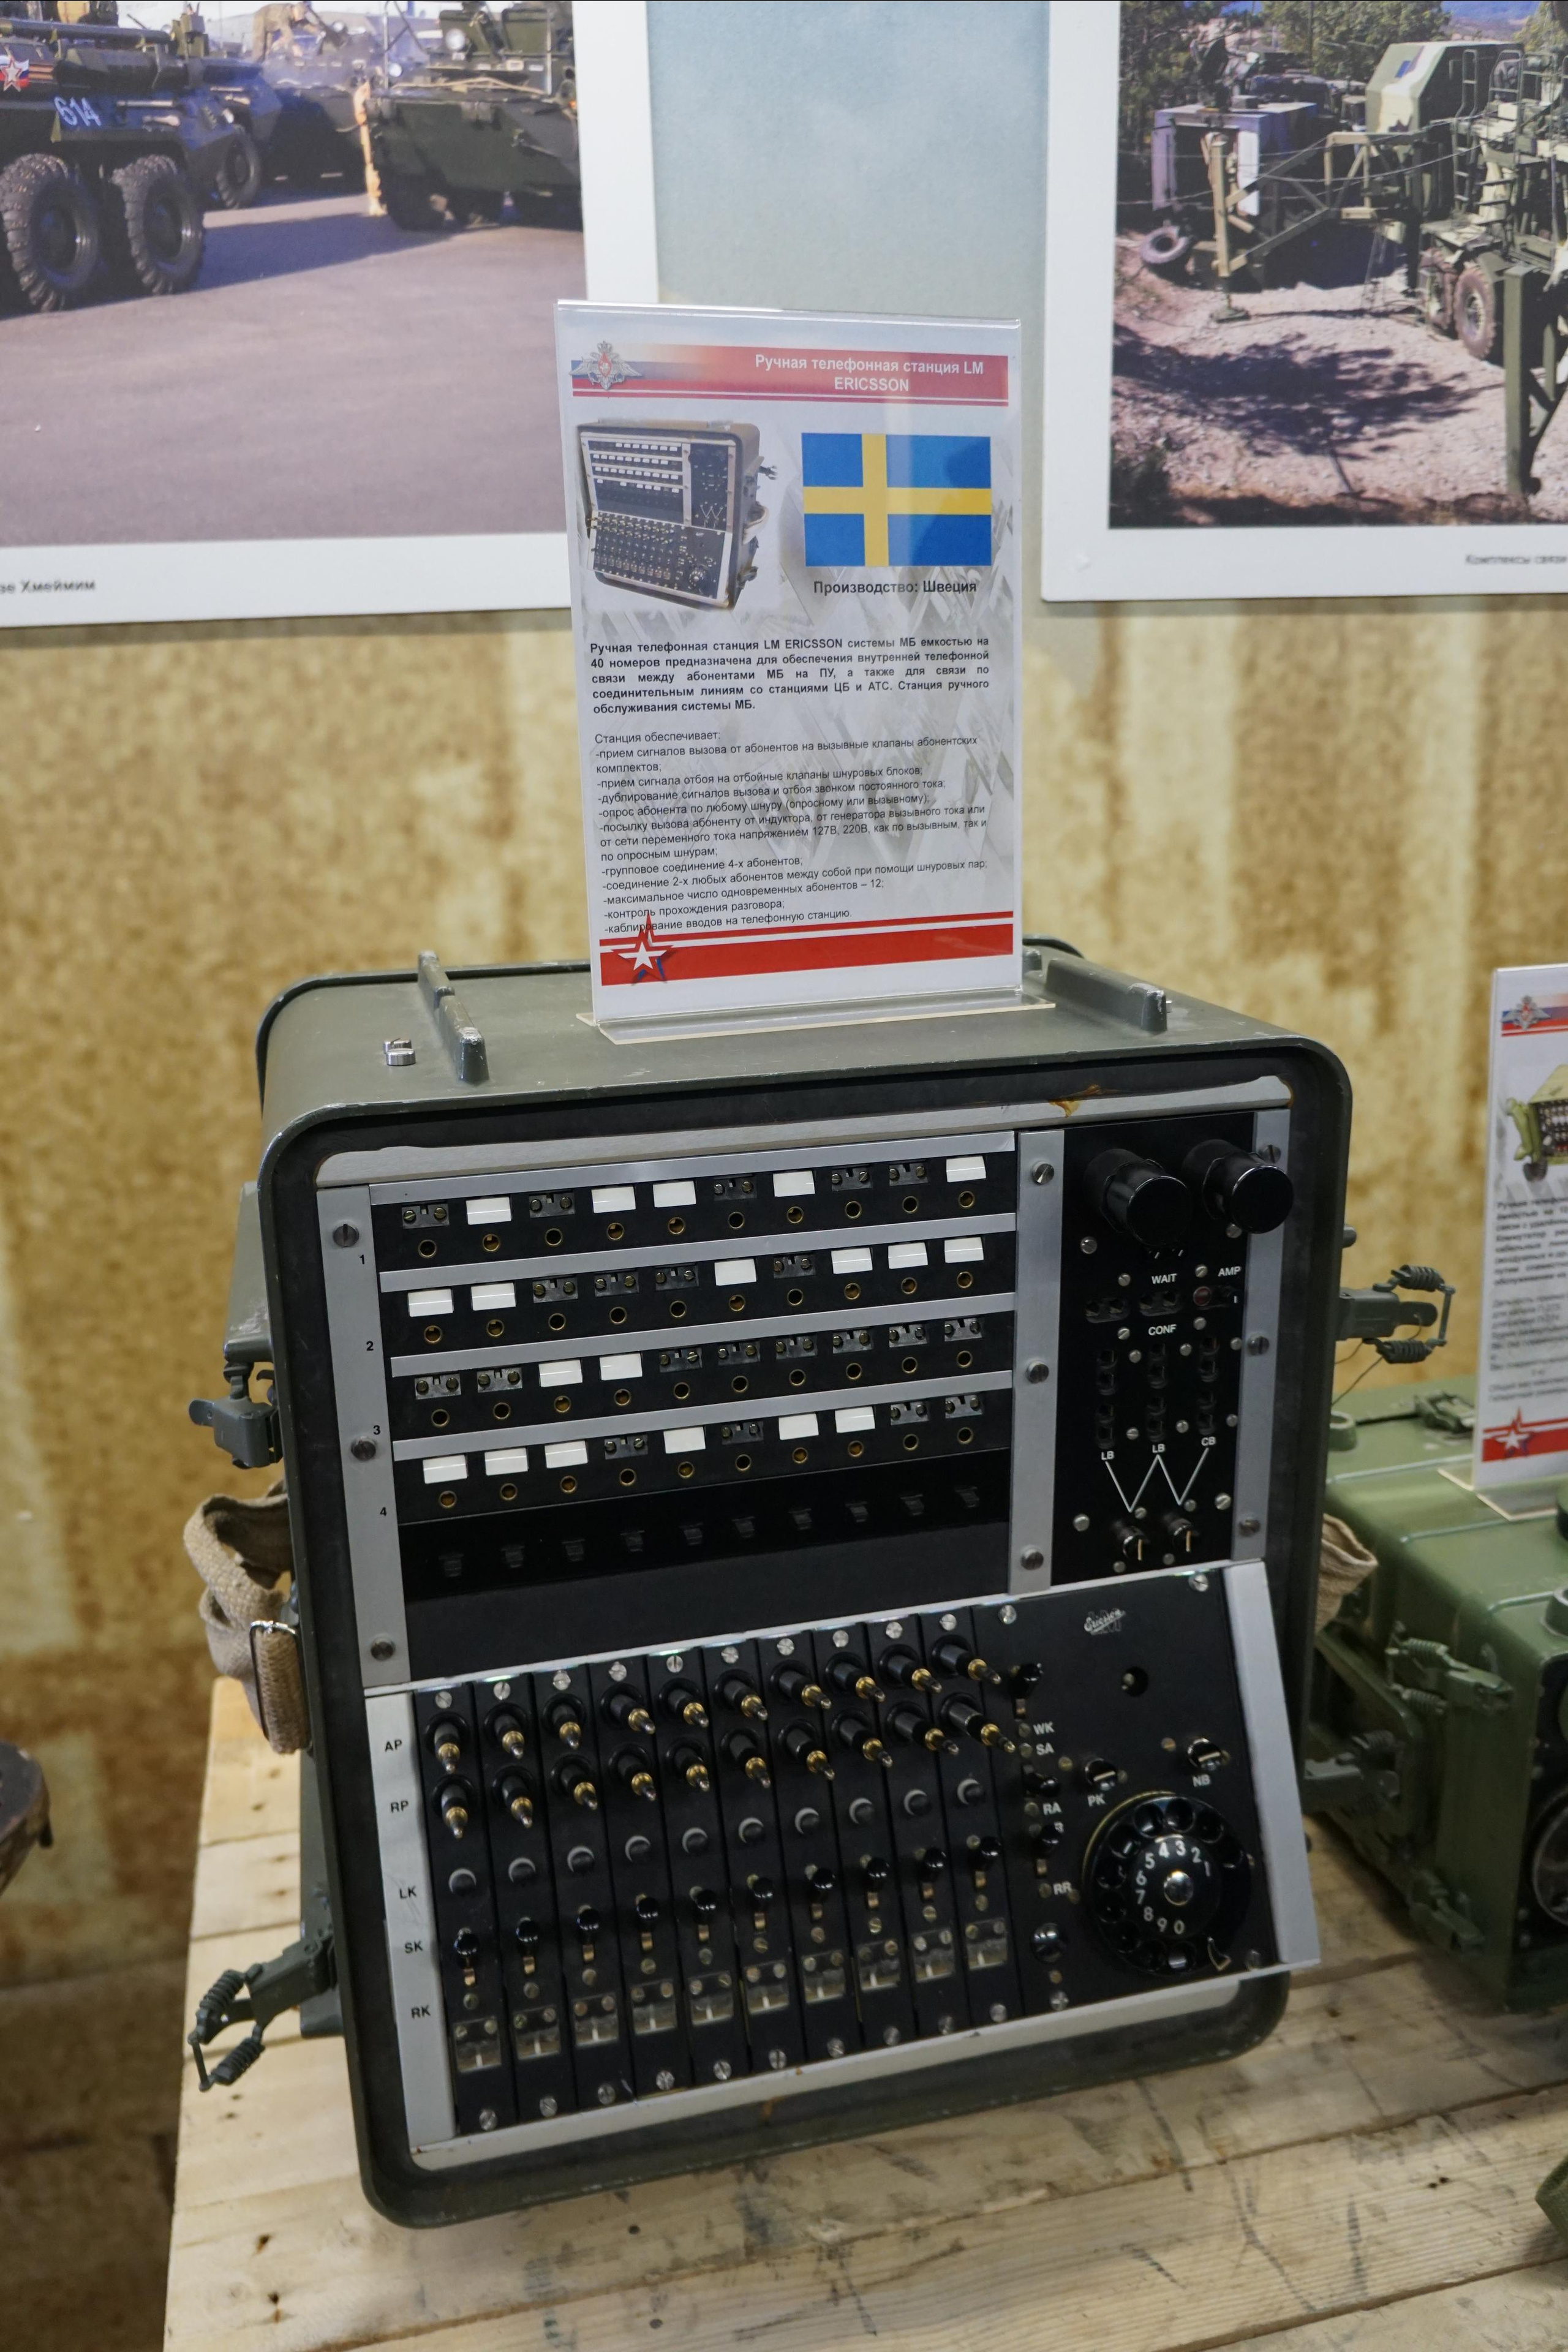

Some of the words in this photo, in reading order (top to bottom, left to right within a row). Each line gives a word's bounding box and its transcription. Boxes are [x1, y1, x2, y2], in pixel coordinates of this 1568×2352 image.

[54, 97, 102, 127] 614
[755, 354, 807, 371] Ручная
[811, 358, 899, 374] телефонная
[903, 362, 959, 375] станция
[963, 361, 984, 374] LM
[834, 376, 909, 392] ERICSSON
[813, 580, 919, 594] Производство:
[922, 579, 977, 595] Швеция
[590, 643, 632, 654] Ручная
[636, 641, 707, 653] телефонная
[712, 642, 759, 652] станция
[763, 639, 780, 649] LM
[785, 638, 842, 649] ERICSSON
[847, 639, 894, 648] системы
[899, 636, 916, 647] МБ
[920, 638, 972, 647] емкостью
[590, 658, 604, 668] 40
[609, 658, 660, 669] номеров
[665, 657, 752, 668] предназначена
[756, 656, 777, 666] для
[782, 653, 853, 664] обеспечения
[857, 651, 920, 664] внутренней
[924, 650, 989, 663] телефонной
[591, 674, 625, 683] связи
[638, 673, 674, 684] между
[686, 670, 755, 681] абонентами
[766, 668, 784, 679] МБ
[819, 667, 836, 679] ПУ,
[864, 668, 894, 677] также
[904, 668, 925, 677] для
[935, 666, 966, 675] связи
[592, 688, 694, 700] соединительным
[699, 687, 744, 696] линиям
[749, 686, 763, 695] со
[768, 684, 828, 695] станциями
[834, 681, 850, 692] ЦБ
[867, 680, 892, 691] АТС.
[897, 680, 942, 691] Станция
[948, 680, 989, 691] ручного
[592, 703, 677, 715] обслуживания
[680, 701, 731, 711] системы
[734, 698, 755, 709] МБ.
[594, 733, 641, 744] Станция
[644, 731, 720, 742] обеспечивает:
[595, 749, 633, 761] -прием
[636, 747, 685, 757] сигналов
[688, 746, 726, 755] вызова
[744, 742, 799, 753] абонентов
[801, 742, 814, 751] на
[816, 741, 869, 751] вызывные
[872, 739, 914, 748] клапаны
[916, 736, 978, 747] абонентских
[596, 763, 662, 774] комплектов;
[597, 778, 635, 790] -прием
[638, 777, 680, 787] сигнала
[683, 774, 714, 785] отбоя
[717, 775, 730, 783] на
[733, 771, 783, 783] отбойные
[786, 771, 829, 781] клапаны
[832, 769, 883, 780] шнуровых
[886, 766, 922, 776] блоков;
[597, 789, 678, 806] -дублирование
[681, 789, 730, 800] сигналов
[733, 787, 770, 797] вызова
[773, 787, 780, 796] и
[782, 783, 812, 796] отбоя
[814, 784, 855, 794] звонком
[858, 781, 920, 792] постоянного
[921, 780, 946, 791] тока;
[600, 839, 611, 847] от
[614, 837, 638, 846] сети
[641, 833, 710, 846] переменного
[712, 832, 736, 841] тока
[739, 828, 809, 841] напряжением
[963, 820, 979, 829] так
[600, 853, 614, 861] по
[616, 850, 670, 862] опросным
[673, 847, 717, 859] шнурам;
[601, 864, 659, 878] -групповое
[662, 861, 725, 873] соединение
[727, 859, 744, 869] 4-х
[746, 857, 802, 868] абонентов;
[601, 878, 669, 891] -соединение
[672, 875, 688, 886] 2-х
[691, 873, 726, 885] любых
[729, 872, 783, 883] абонентов
[786, 870, 819, 880] между
[821, 866, 851, 877] собой
[854, 867, 872, 877] при
[874, 864, 914, 874] помощи
[916, 862, 965, 873] шнуровых
[968, 861, 987, 870] пар;
[603, 892, 684, 905] -максимальное
[687, 890, 718, 899] число
[720, 884, 802, 899] одновременных
[805, 881, 858, 892] абонентов
[870, 878, 884, 888] 12;
[603, 908, 656, 919] -контроль
[658, 903, 728, 917] прохождения
[731, 900, 785, 913] разговора;
[604, 919, 682, 933] -каблирование
[685, 918, 722, 929] вводов
[725, 917, 738, 925] на
[740, 913, 804, 925] телефонную
[807, 910, 851, 920] станцию.
[359, 1254, 365, 1265] 1
[1151, 1273, 1177, 1284] WAIT
[1218, 1266, 1241, 1277] AMP
[1148, 1324, 1177, 1336] CONF
[366, 1341, 374, 1351] 2
[373, 1425, 381, 1436] 3
[1152, 1443, 1166, 1453] LB
[1201, 1436, 1216, 1447] CB
[1101, 1450, 1115, 1461] LB
[380, 1507, 387, 1517] 4
[1033, 1722, 1055, 1735] WK
[385, 1739, 402, 1752] AP
[1036, 1742, 1054, 1755] SA
[1193, 1774, 1211, 1787] NB
[390, 1800, 409, 1813] RP
[1087, 1793, 1106, 1807] PK
[1042, 1802, 1061, 1815] RA
[1157, 1841, 1170, 1858] 4
[1175, 1839, 1186, 1856] 3
[1191, 1846, 1202, 1863] 2
[1145, 1852, 1155, 1869] 5
[1204, 1861, 1210, 1877] 1
[1136, 1870, 1147, 1886] 6
[399, 1886, 417, 1899] LK
[1053, 1881, 1072, 1895] RR
[1135, 1889, 1146, 1904] 7
[1144, 1906, 1154, 1921] 8
[1157, 1917, 1167, 1932] 9
[404, 1940, 423, 1954] SK
[411, 2005, 431, 2019] RK
